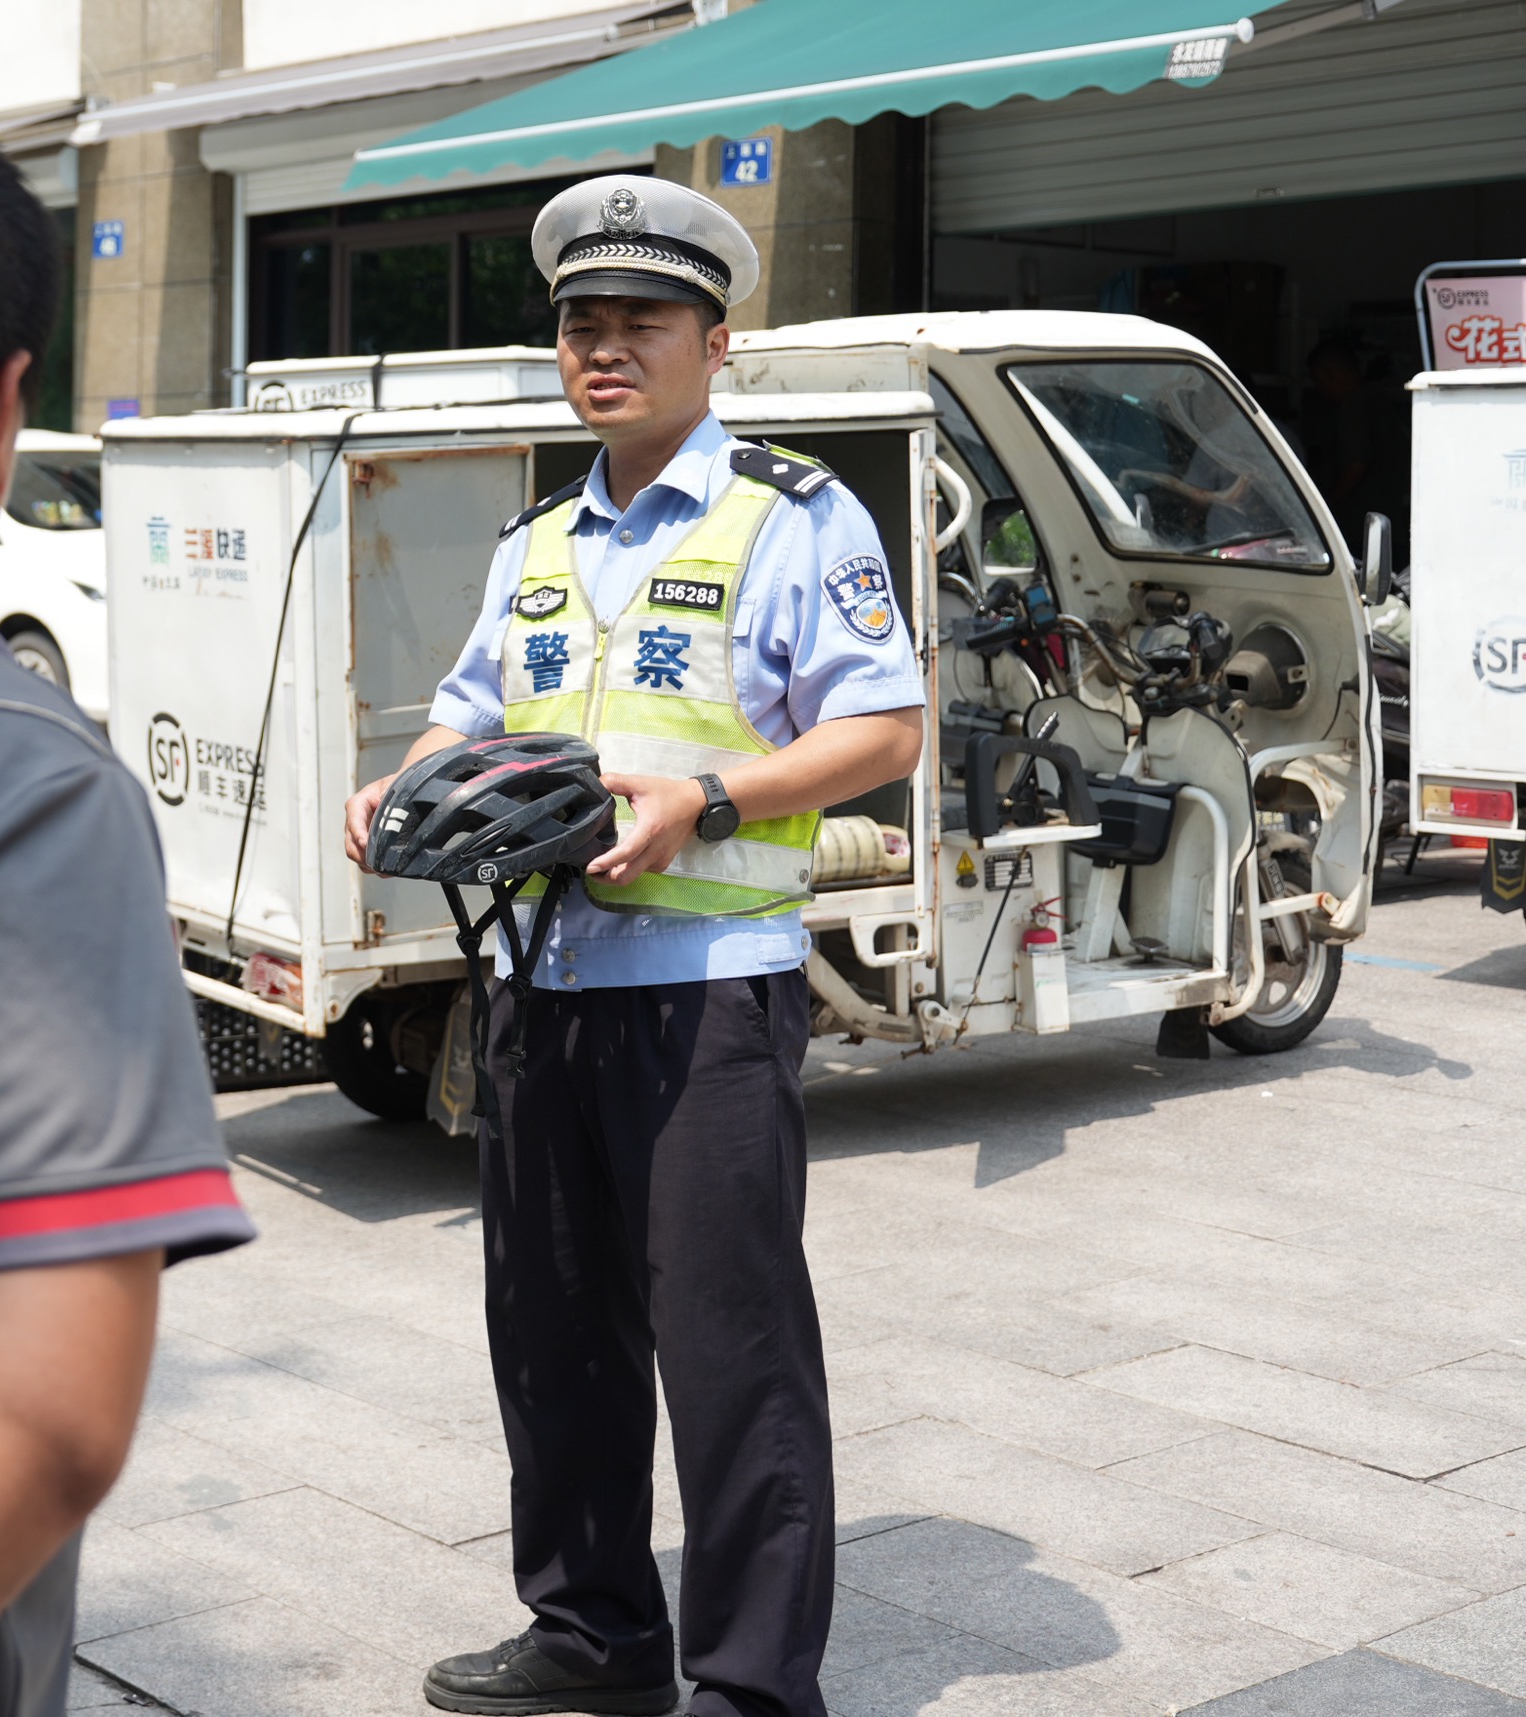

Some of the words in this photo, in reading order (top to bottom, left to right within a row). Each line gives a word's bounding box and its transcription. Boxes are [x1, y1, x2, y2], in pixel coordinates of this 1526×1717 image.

[735, 160, 758, 182] 42
[654, 583, 718, 605] 156288
[523, 631, 570, 693] 警
[633, 625, 691, 690] 察
[196, 739, 265, 777] EXPRESS
